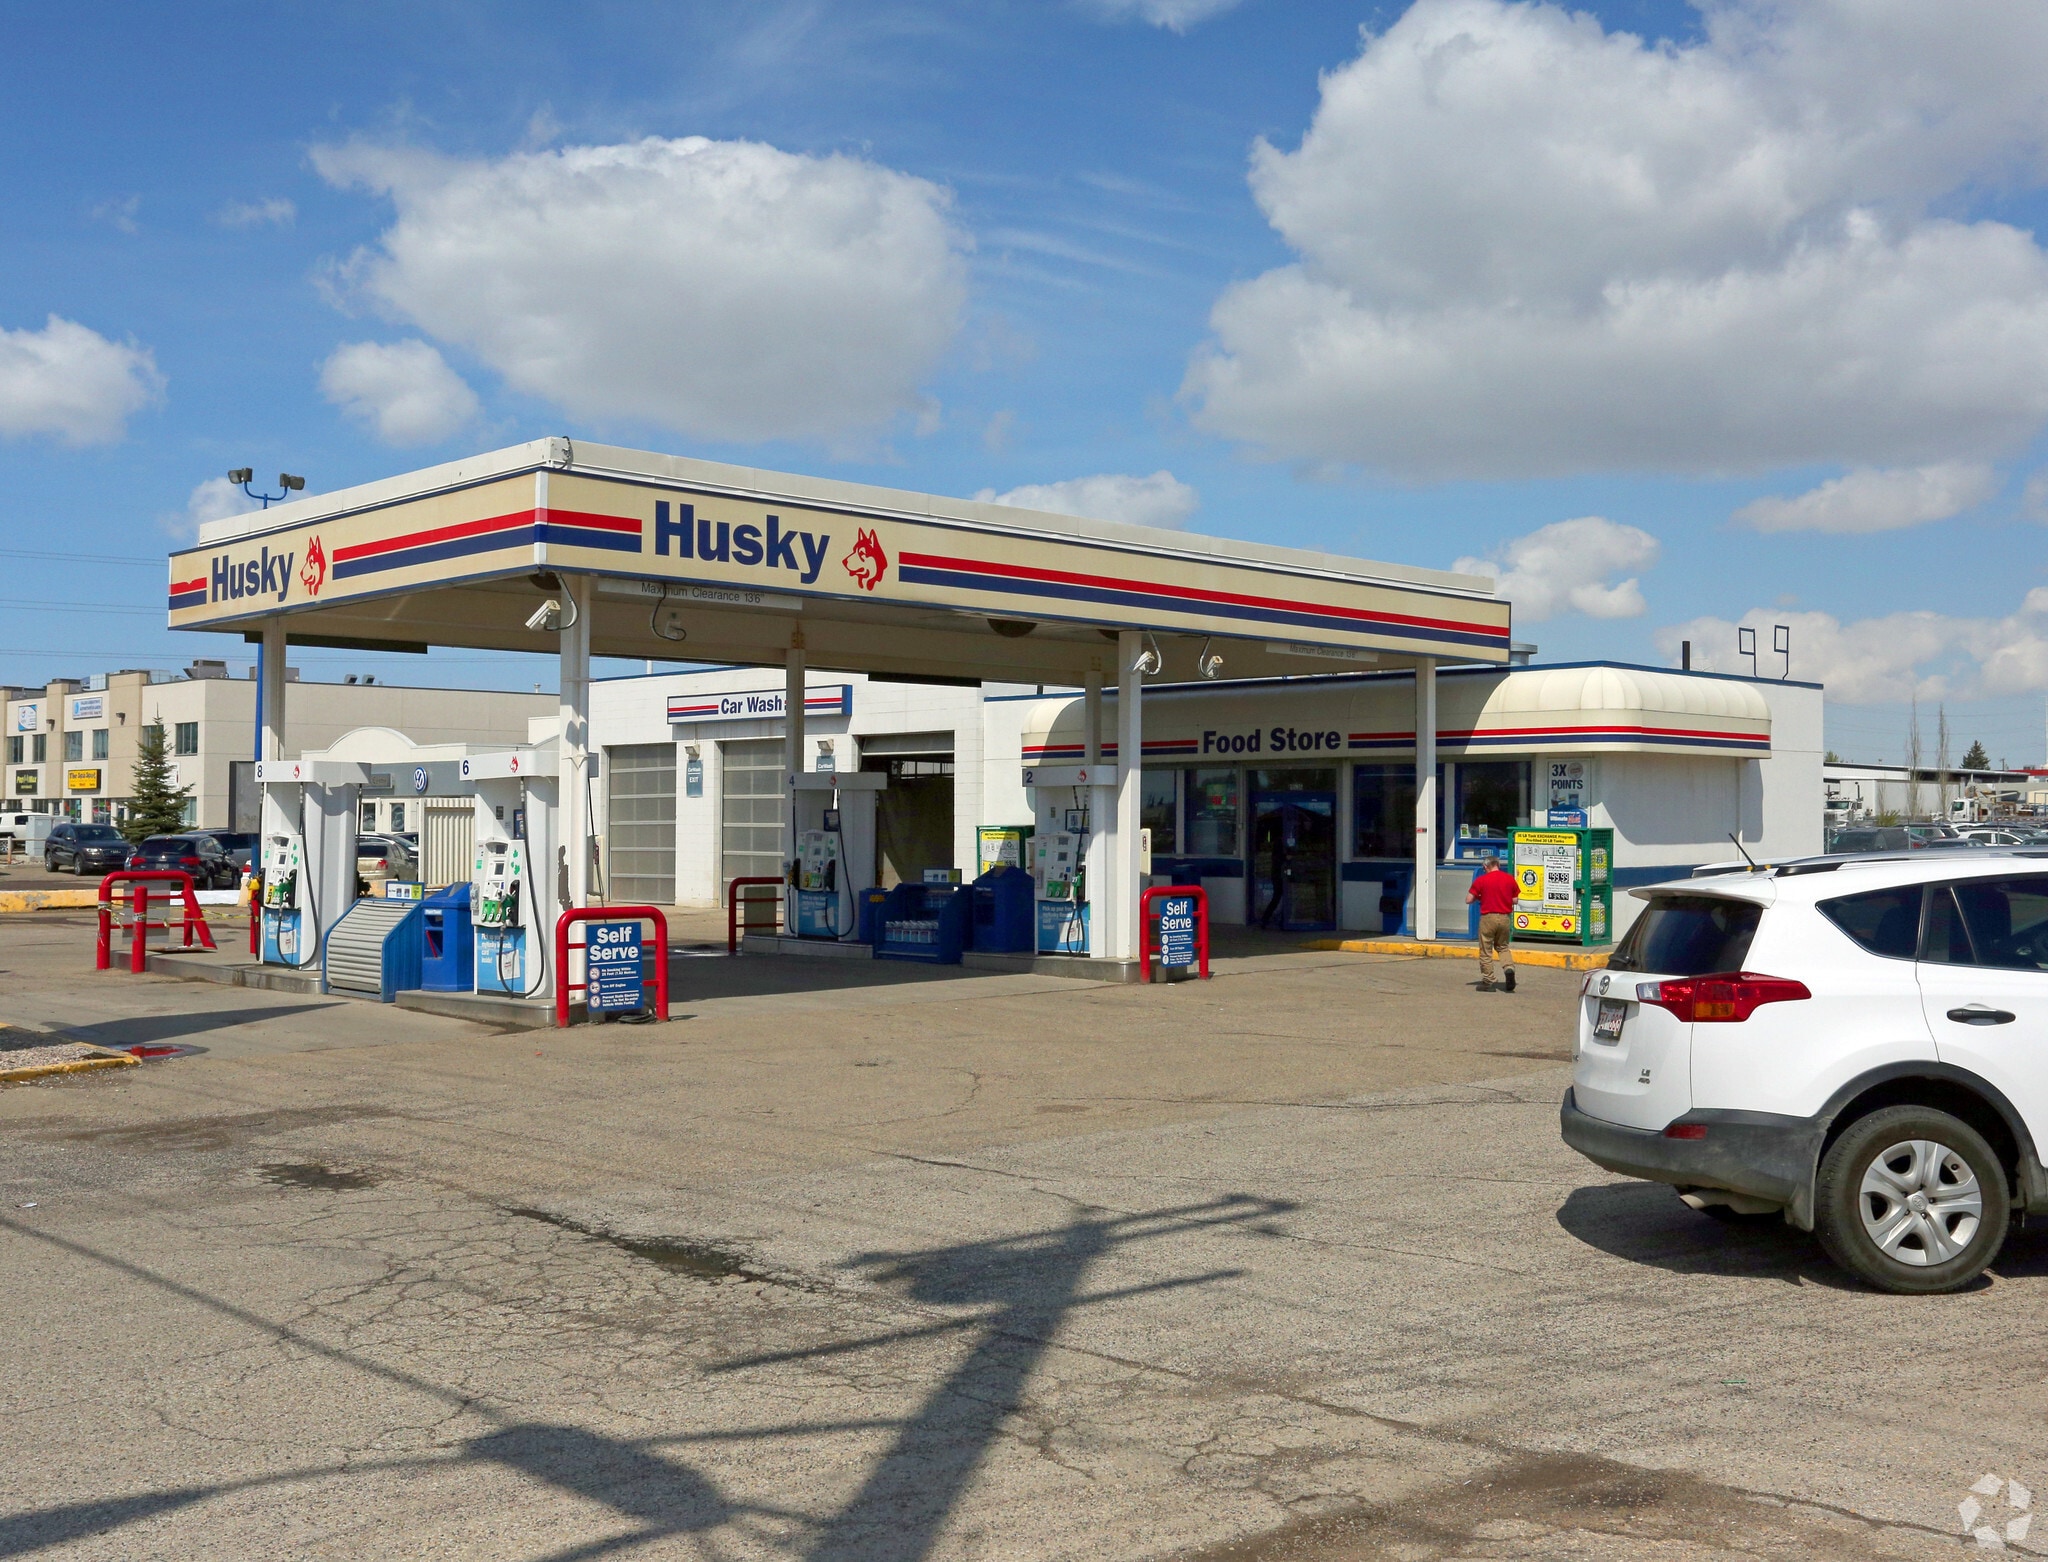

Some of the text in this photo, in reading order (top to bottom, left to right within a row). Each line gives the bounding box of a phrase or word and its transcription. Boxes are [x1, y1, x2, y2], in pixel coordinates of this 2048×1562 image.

[655, 500, 830, 584] Husky
[212, 546, 294, 603] Husky
[641, 582, 688, 597] Maximum
[692, 587, 740, 602] Clearance
[721, 695, 783, 714] Car Wash
[1203, 727, 1341, 753] Food Store
[257, 764, 263, 778] 8
[462, 759, 470, 776] 6
[1551, 764, 1567, 777] 3X
[789, 775, 795, 786] 4
[1026, 771, 1033, 783] 2
[1551, 779, 1583, 790] POINTS
[1166, 901, 1187, 915] Self
[1162, 916, 1192, 930] Serve
[597, 926, 632, 944] Self
[589, 945, 639, 961] Serve
